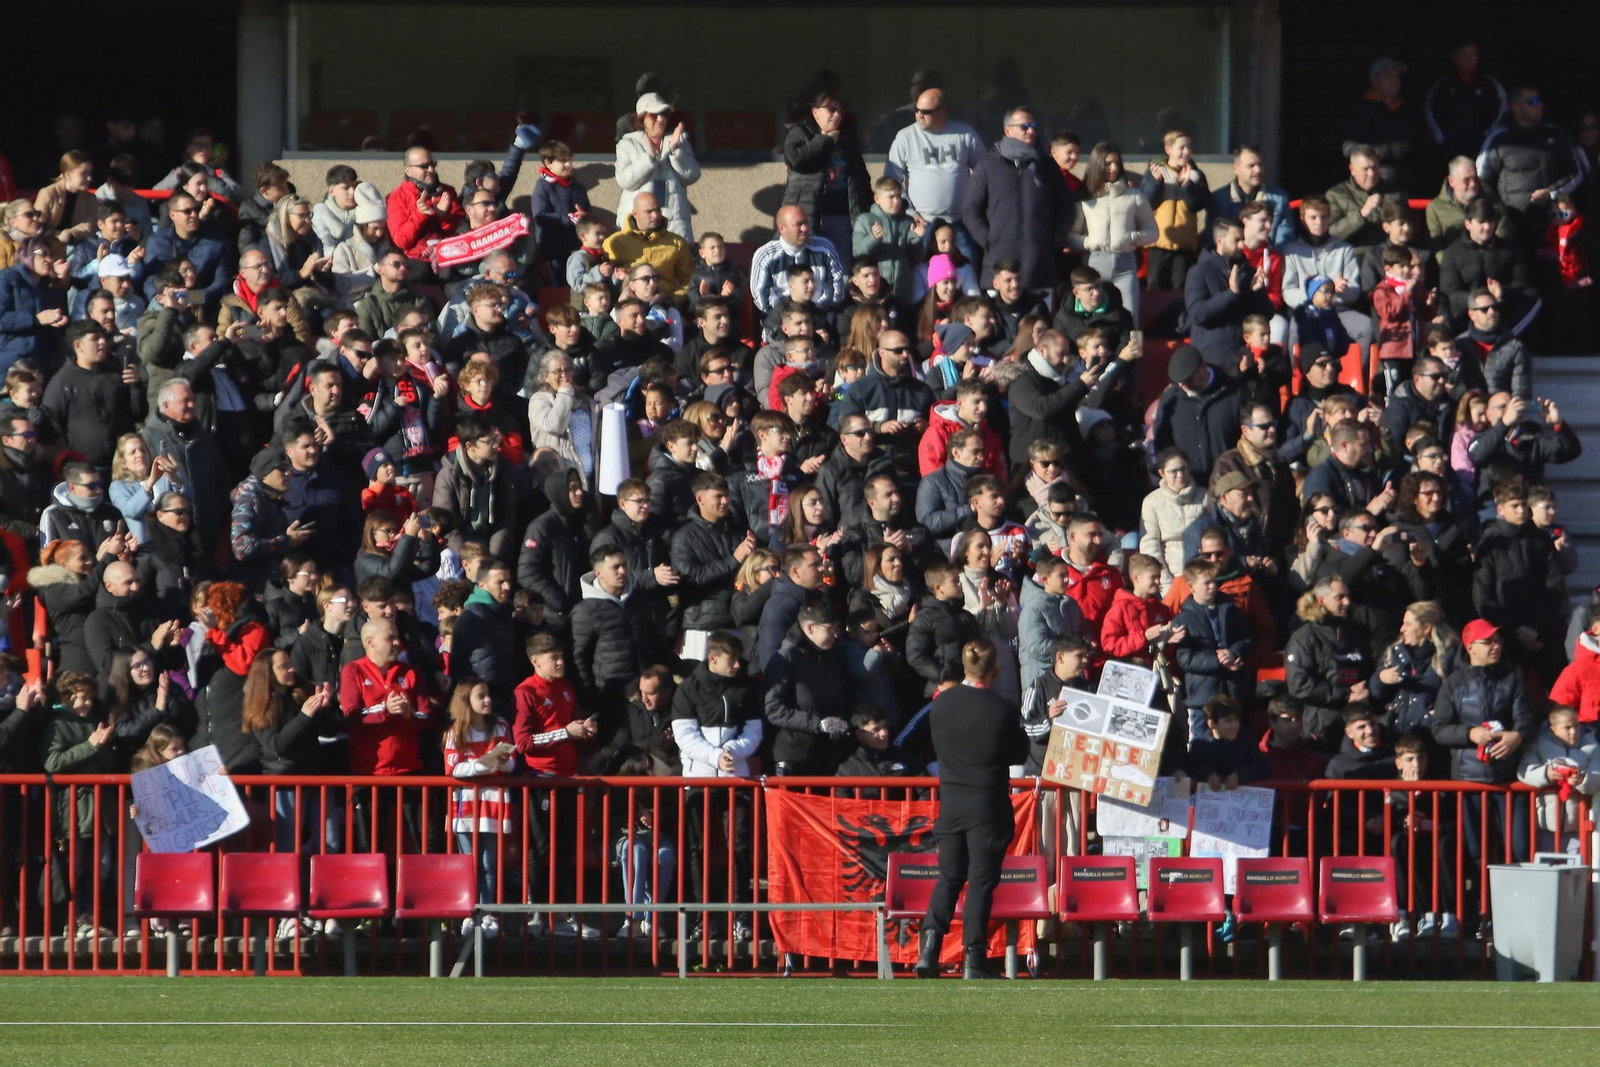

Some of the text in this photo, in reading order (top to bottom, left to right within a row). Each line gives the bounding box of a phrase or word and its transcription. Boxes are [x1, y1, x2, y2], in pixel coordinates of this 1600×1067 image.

[922, 144, 957, 165] HH
[470, 226, 511, 250] GRANADA
[1062, 730, 1152, 769] REINIER
[1082, 754, 1113, 778] ME
[1046, 760, 1074, 780] DAS
[1079, 774, 1115, 796] TUS
[1198, 803, 1220, 820] ME
[1205, 820, 1237, 836] DAR
[900, 868, 929, 876] BANQUILLO
